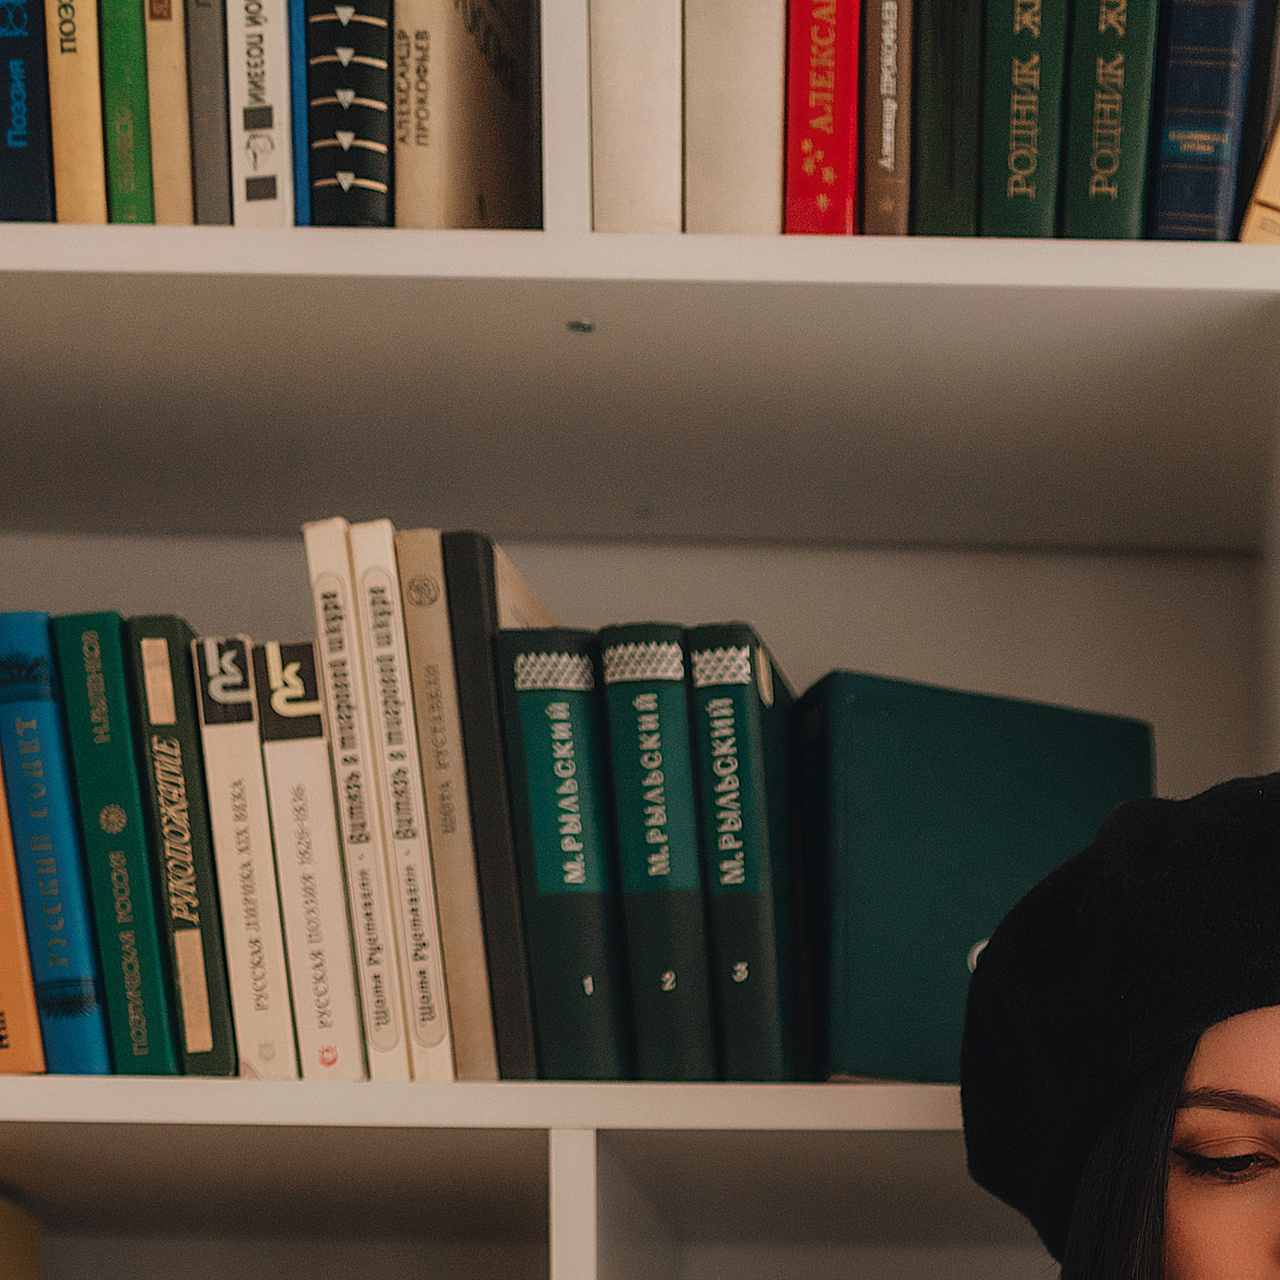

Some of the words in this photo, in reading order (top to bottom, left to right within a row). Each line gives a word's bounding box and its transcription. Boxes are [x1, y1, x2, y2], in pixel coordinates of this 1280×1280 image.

[57, 0, 77, 54] ПОЭ
[246, 34, 266, 105] ПОЭЗИИ
[808, 0, 837, 135] АЛЕКСА
[7, 59, 28, 148] Поэзия
[1005, 52, 1042, 200] РОДНИК
[1089, 52, 1126, 200] РОДНИК
[14, 714, 50, 820] СОНЕТ
[150, 734, 200, 925] РУКОПОЖАТИЕ
[108, 849, 134, 924] РОССИЯ
[660, 968, 678, 992] 2
[730, 960, 751, 984] 3
